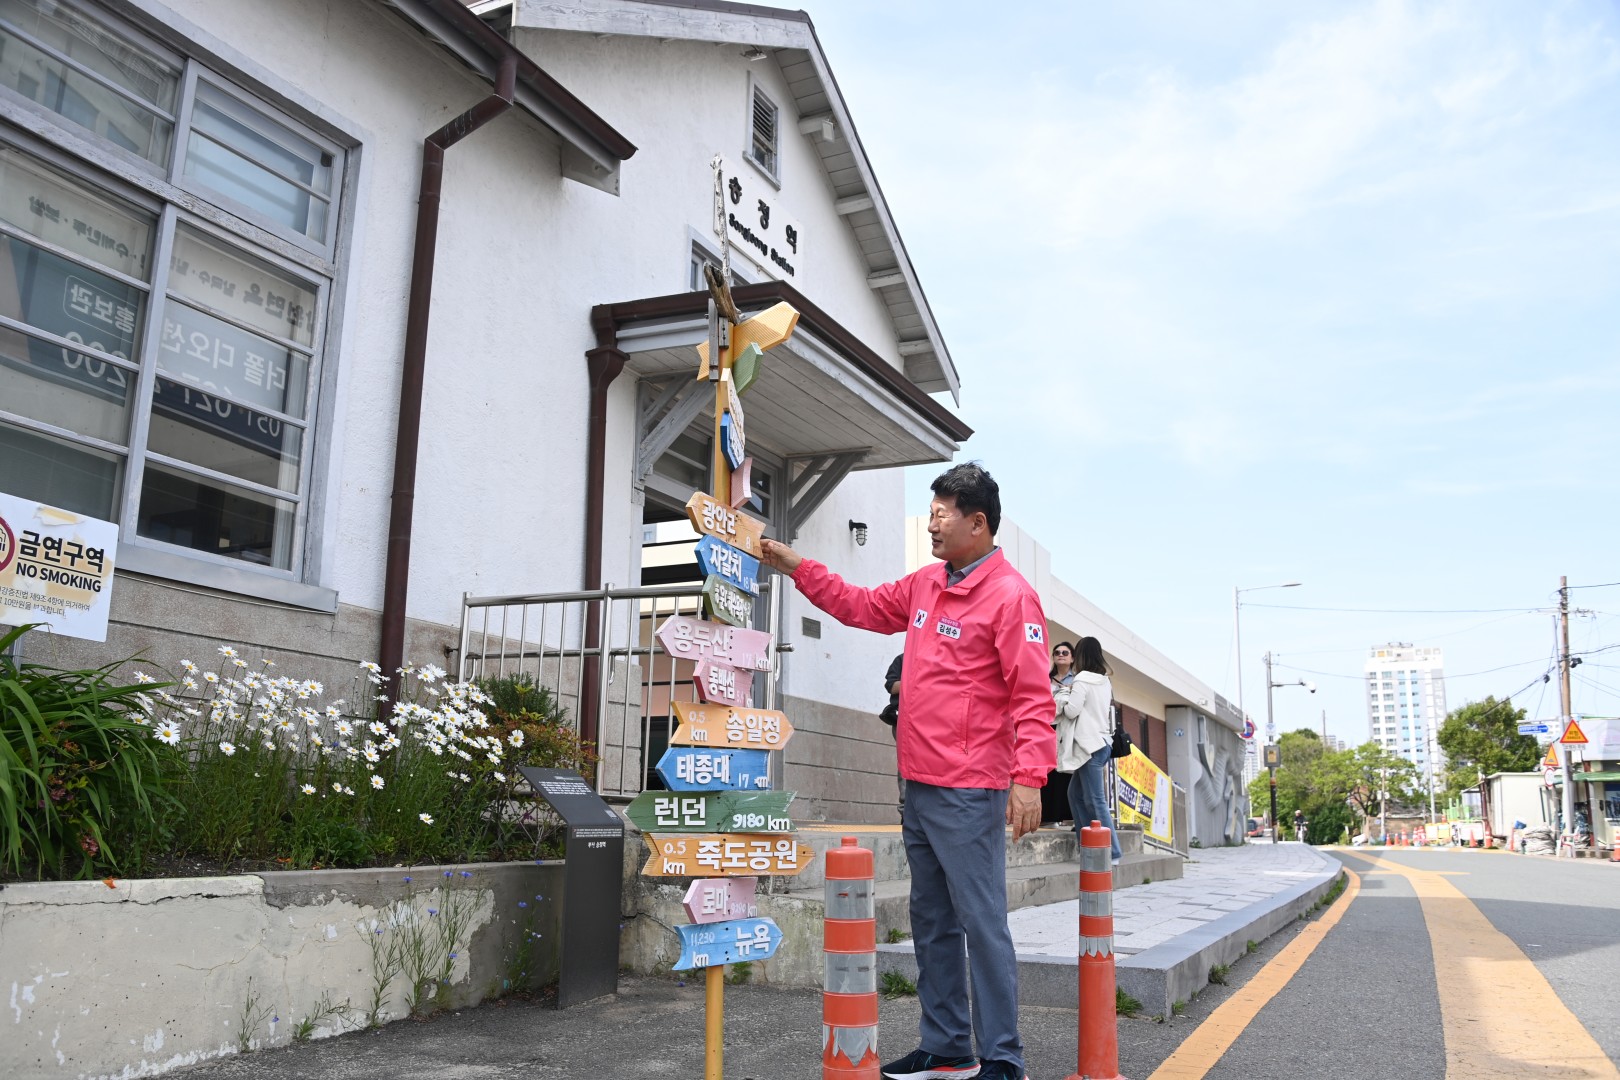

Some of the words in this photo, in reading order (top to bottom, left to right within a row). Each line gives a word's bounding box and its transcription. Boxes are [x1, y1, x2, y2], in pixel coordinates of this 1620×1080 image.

[728, 176, 797, 254] 송정역
[771, 248, 794, 277] Station
[19, 530, 104, 573] 금연구역
[710, 543, 743, 583] 자갈치
[16, 562, 37, 578] NO
[39, 567, 102, 592] SMOKING
[0, 586, 29, 599] 강증진법
[4, 598, 32, 611] 10만원을
[939, 624, 958, 636] 김성수
[673, 621, 728, 658] 용두산
[755, 653, 769, 670] km
[707, 666, 736, 700] 동백섬
[689, 711, 706, 724] 0.5
[725, 712, 780, 744] 송일정
[690, 725, 708, 742] km
[676, 753, 730, 785] 태종대
[738, 773, 750, 789] 17
[654, 797, 706, 827] 런던
[732, 813, 765, 829] 9180
[767, 814, 791, 831] km
[663, 841, 687, 855] 0.5
[695, 840, 797, 870] 죽도공원
[662, 858, 686, 875] km
[701, 886, 728, 915] 로마
[747, 902, 758, 917] km
[692, 951, 710, 967] km
[735, 924, 772, 956] 뉴욕
